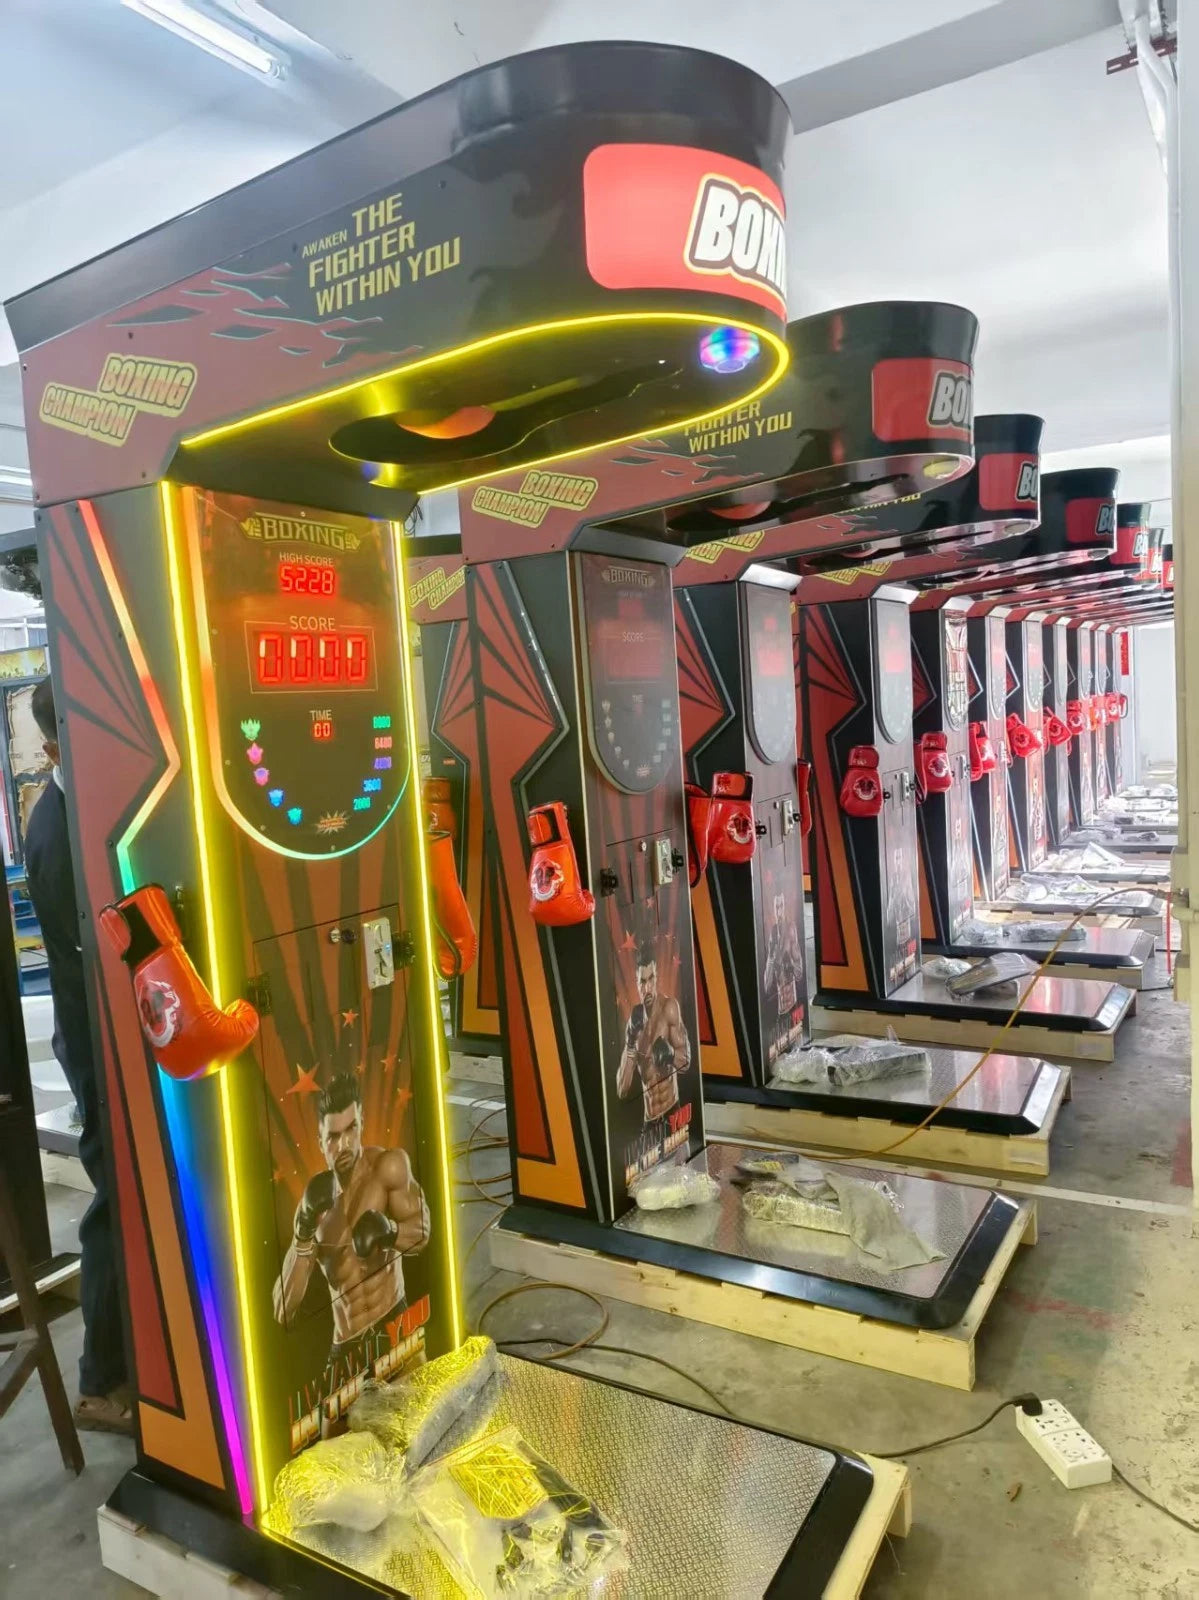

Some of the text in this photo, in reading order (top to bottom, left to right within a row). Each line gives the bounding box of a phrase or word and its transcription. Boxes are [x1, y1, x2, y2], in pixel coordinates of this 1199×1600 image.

[302, 193, 402, 259] AWAKEN THE
[309, 221, 415, 288] FIGHTER
[316, 237, 461, 316] WITHIN YOU
[101, 357, 195, 410] BOXING
[43, 386, 136, 440] CHAMPION
[689, 411, 793, 454] WITHIN YOU
[473, 488, 549, 523] CHAMPION
[519, 472, 596, 506] BOXING
[262, 517, 345, 550] BOXING
[279, 552, 334, 567] HIGH SCORE
[280, 565, 335, 595] 5228
[289, 615, 336, 631] SCORE
[258, 633, 367, 683] 0000
[310, 709, 332, 721] TIME
[314, 722, 331, 738] 00
[385, 1294, 431, 1348] YOU
